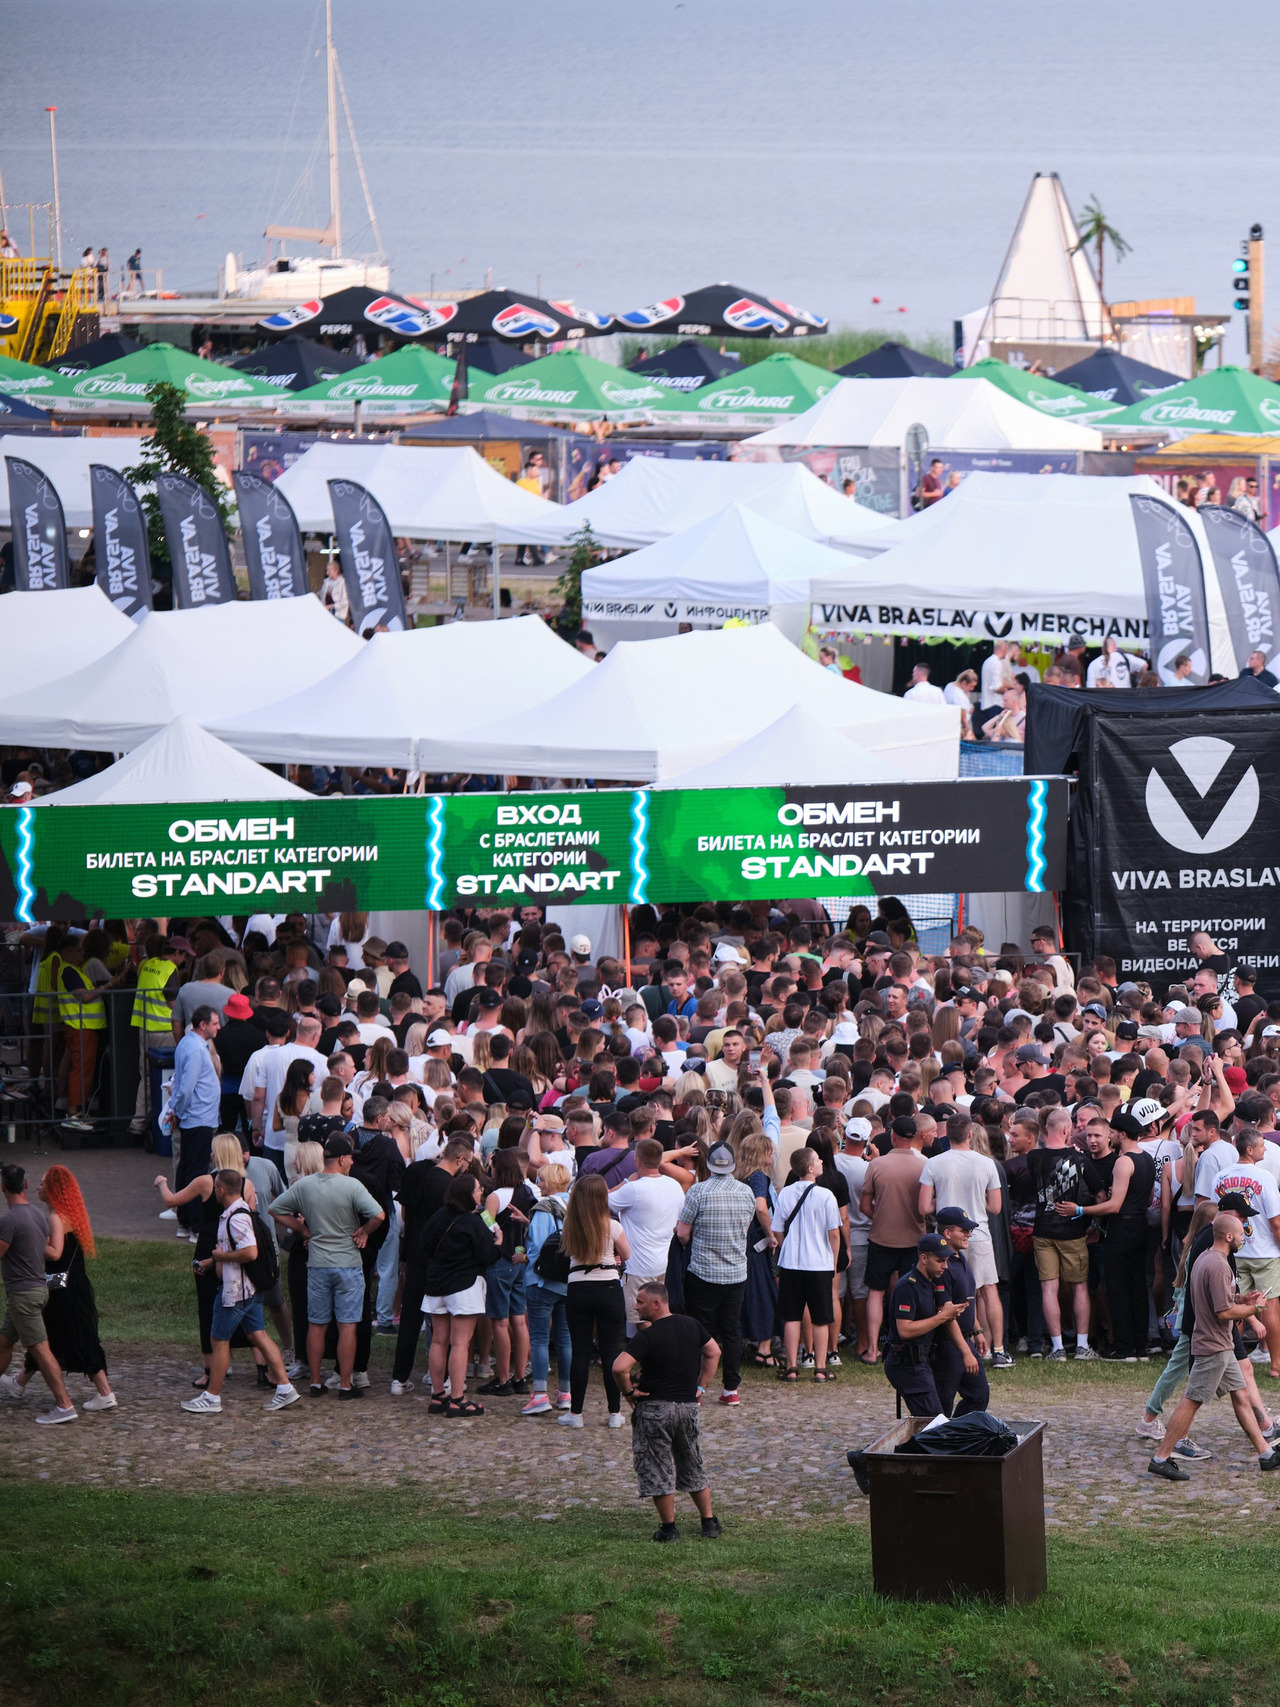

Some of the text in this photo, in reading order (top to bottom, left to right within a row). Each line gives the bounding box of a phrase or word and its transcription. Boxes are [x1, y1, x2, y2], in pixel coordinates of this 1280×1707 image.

[320, 324, 352, 335] PEPSI
[678, 324, 711, 335] PEPSI
[346, 383, 418, 397] TUBORG
[501, 386, 577, 404] TUBORG
[717, 392, 795, 409] TUBORG
[1159, 406, 1236, 424] TUBORG
[822, 604, 872, 624] VIVA
[878, 606, 978, 628] BRASLAV
[496, 804, 581, 825] ВХОД
[777, 801, 900, 826] ОБМЕН
[168, 817, 295, 843] ОБМЕН
[479, 830, 600, 848] С БРАСЛЕТАМИ
[697, 829, 980, 852] БИЛЕТА НА БРАСЛЕТ КАТЕГОРИИ
[86, 846, 378, 869] БИЛЕТА НА БРАСЛЕТ КАТЕГОРИИ
[492, 849, 587, 867] КАТЕГОРИИ
[741, 852, 935, 880] STANDART
[131, 869, 331, 898] STANDART
[456, 870, 621, 895] STANDART
[1112, 871, 1170, 891] VIVA
[1136, 918, 1266, 934] НА ТЕРРИТОРИИ
[1167, 938, 1238, 953] ВЕТСЯ
[1138, 1102, 1159, 1119] VIVA
[1240, 1176, 1263, 1196] BROS
